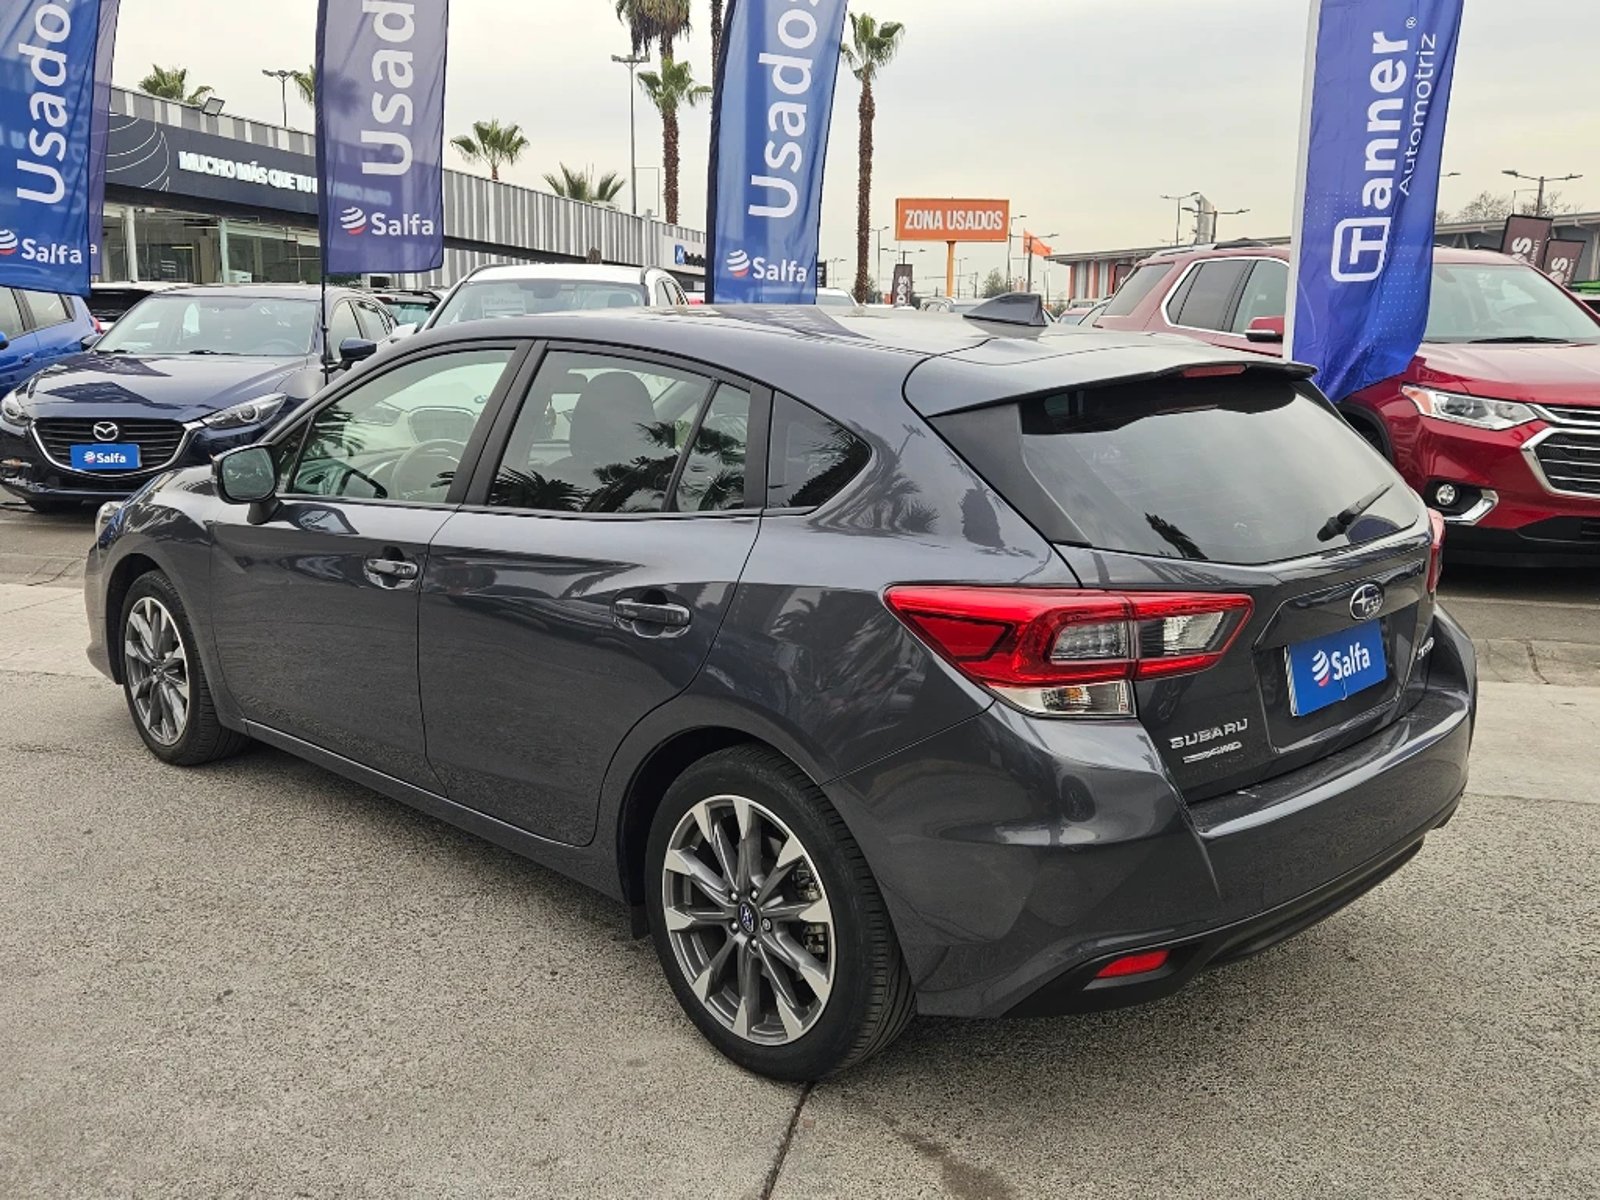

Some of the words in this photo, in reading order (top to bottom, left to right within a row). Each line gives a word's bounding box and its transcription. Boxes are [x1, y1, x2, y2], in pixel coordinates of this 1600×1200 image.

[17, 0, 70, 204] Usado
[748, 0, 819, 218] Usado
[1399, 33, 1436, 196] Automotriz
[178, 151, 236, 178] MUCHO
[235, 160, 267, 184] MÁS
[268, 169, 296, 189] QUE
[371, 212, 434, 235] Salfa
[904, 209, 944, 230] ZONA
[946, 210, 1004, 231] USADOS
[21, 238, 82, 264] Salfa
[752, 256, 807, 282] Salfa
[97, 452, 126, 464] Salfa
[1331, 642, 1371, 680] Salfa
[1168, 718, 1248, 749] SUBARU
